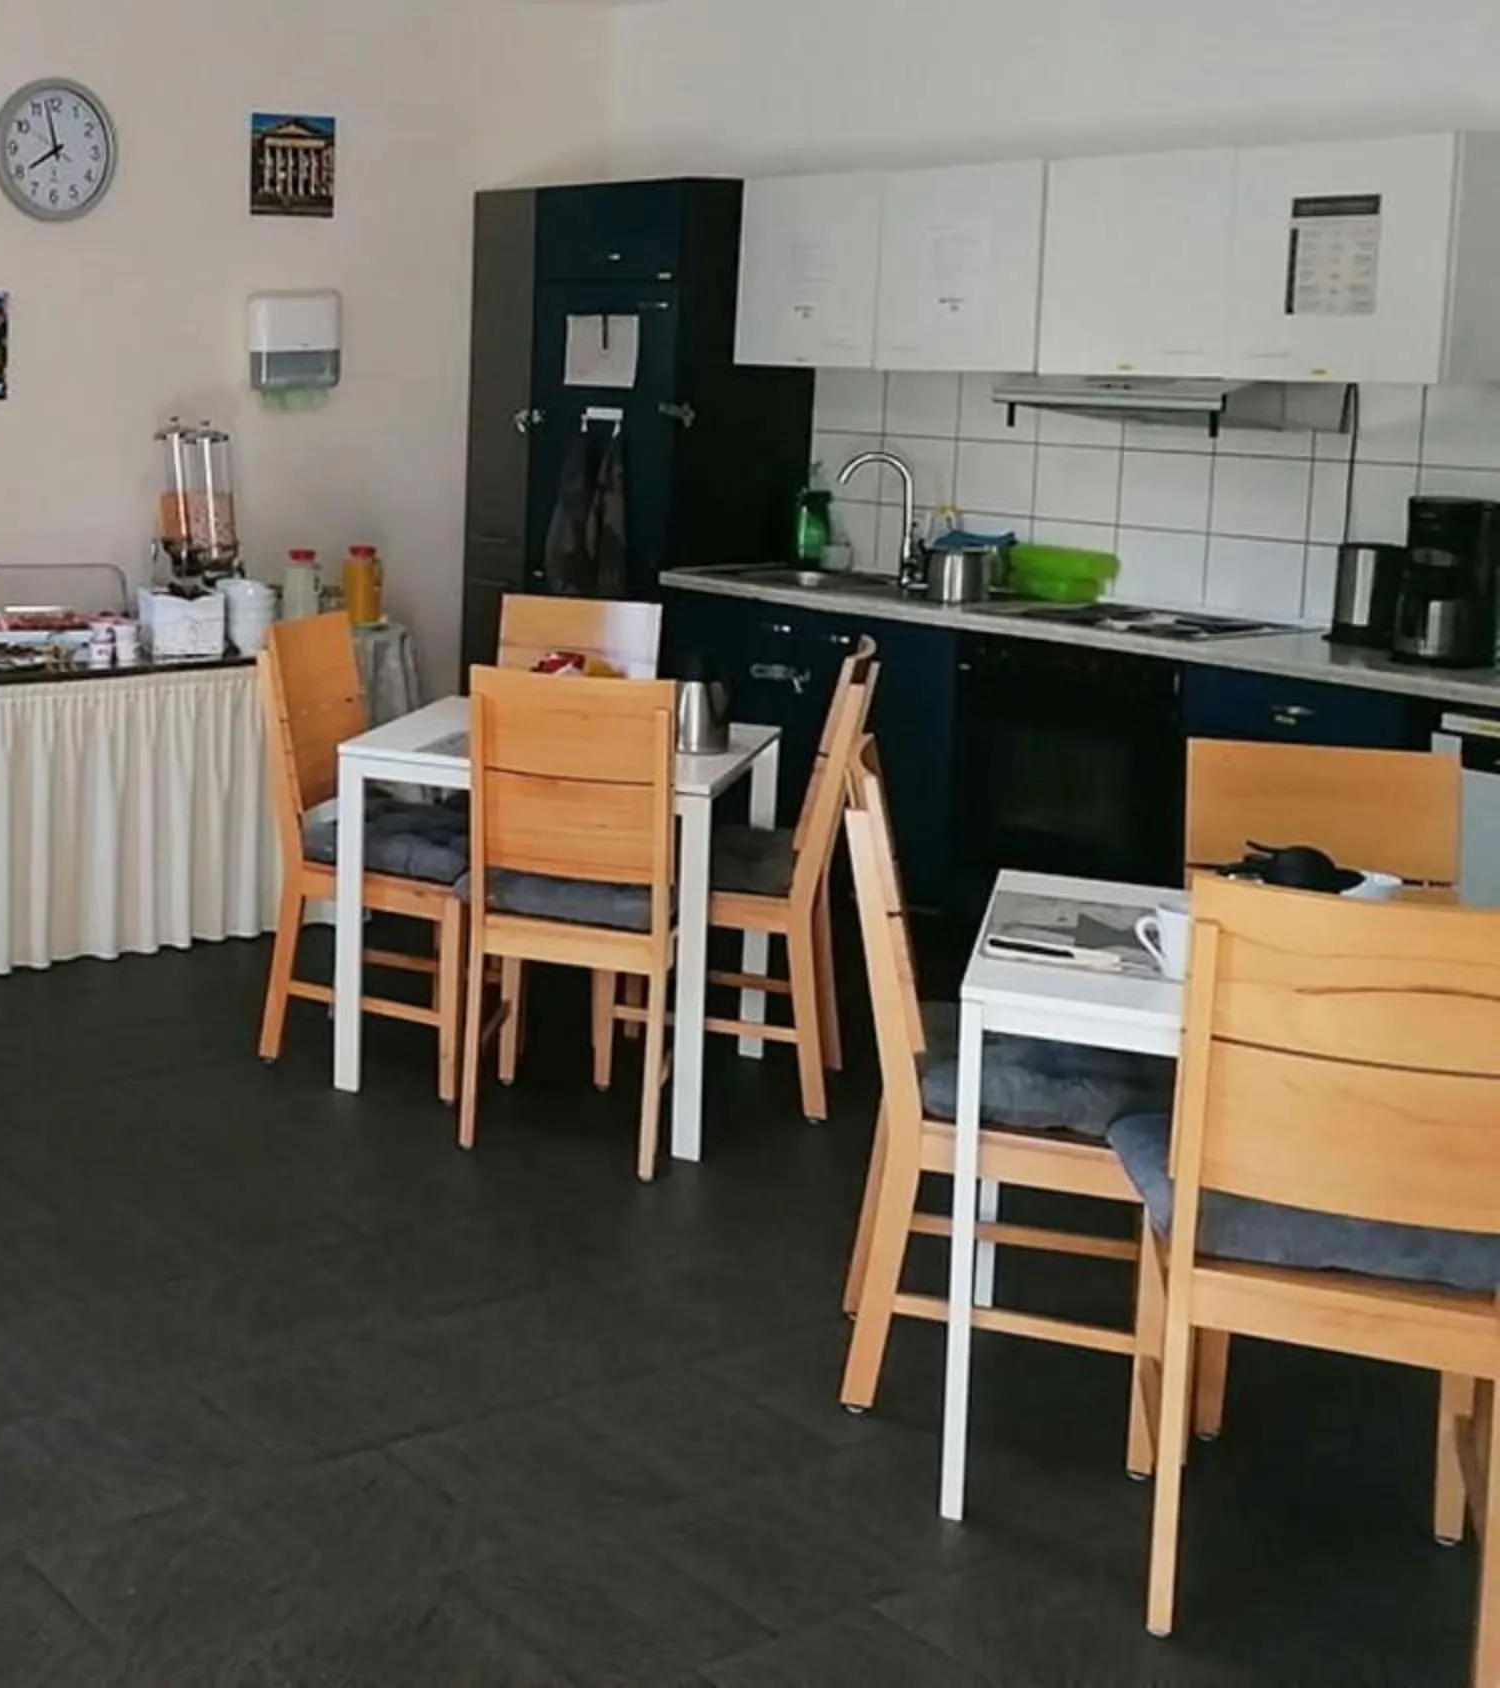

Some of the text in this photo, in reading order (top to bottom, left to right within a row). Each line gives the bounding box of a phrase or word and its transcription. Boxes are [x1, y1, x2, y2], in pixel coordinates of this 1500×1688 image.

[72, 105, 79, 119] 1
[17, 119, 30, 134] 10
[84, 121, 94, 138] 2
[8, 140, 18, 156] 9
[90, 144, 100, 161] 3
[15, 164, 25, 180] 8
[83, 168, 94, 182] 4
[30, 181, 39, 196] 7
[48, 188, 59, 204] 6
[68, 183, 79, 199] 5
